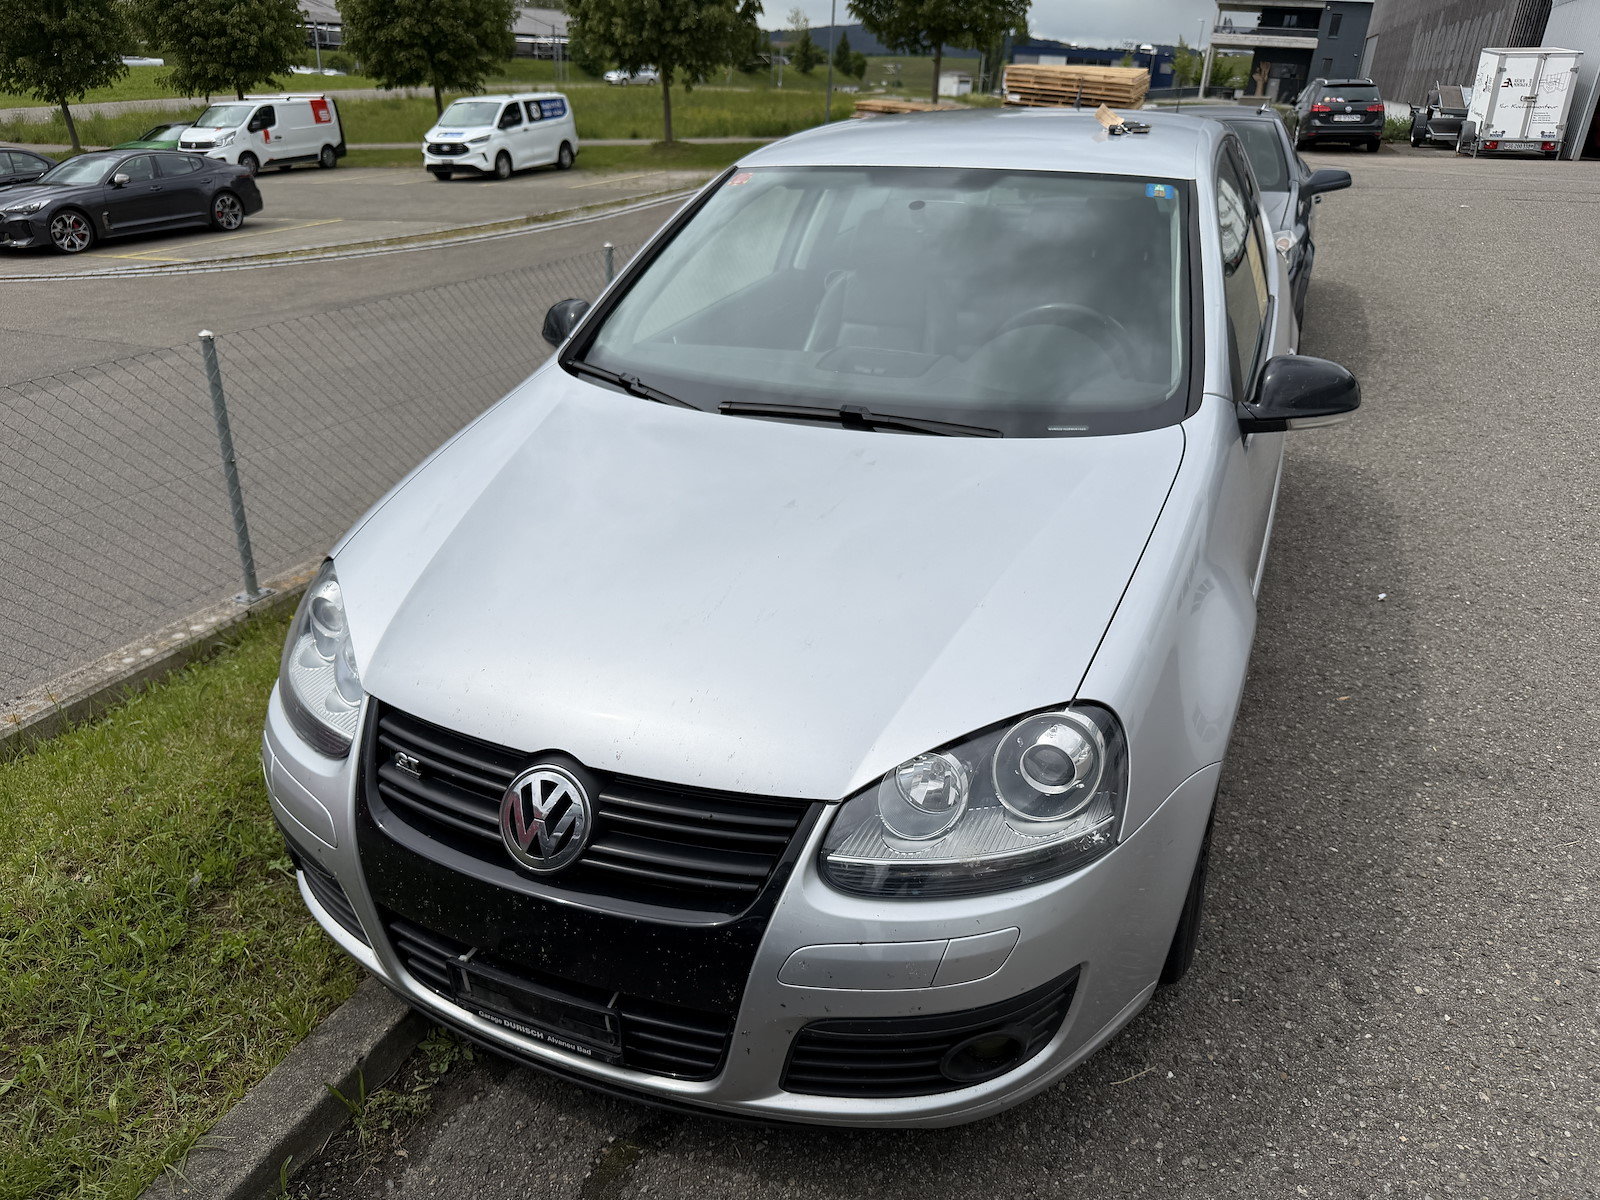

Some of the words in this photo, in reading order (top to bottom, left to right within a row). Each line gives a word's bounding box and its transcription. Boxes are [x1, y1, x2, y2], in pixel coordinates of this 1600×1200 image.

[394, 751, 420, 774] GT
[478, 1010, 503, 1024] Garage
[503, 1019, 544, 1039] DURISCH
[547, 1035, 576, 1050] Alvaneu
[577, 1045, 592, 1056] Bad
